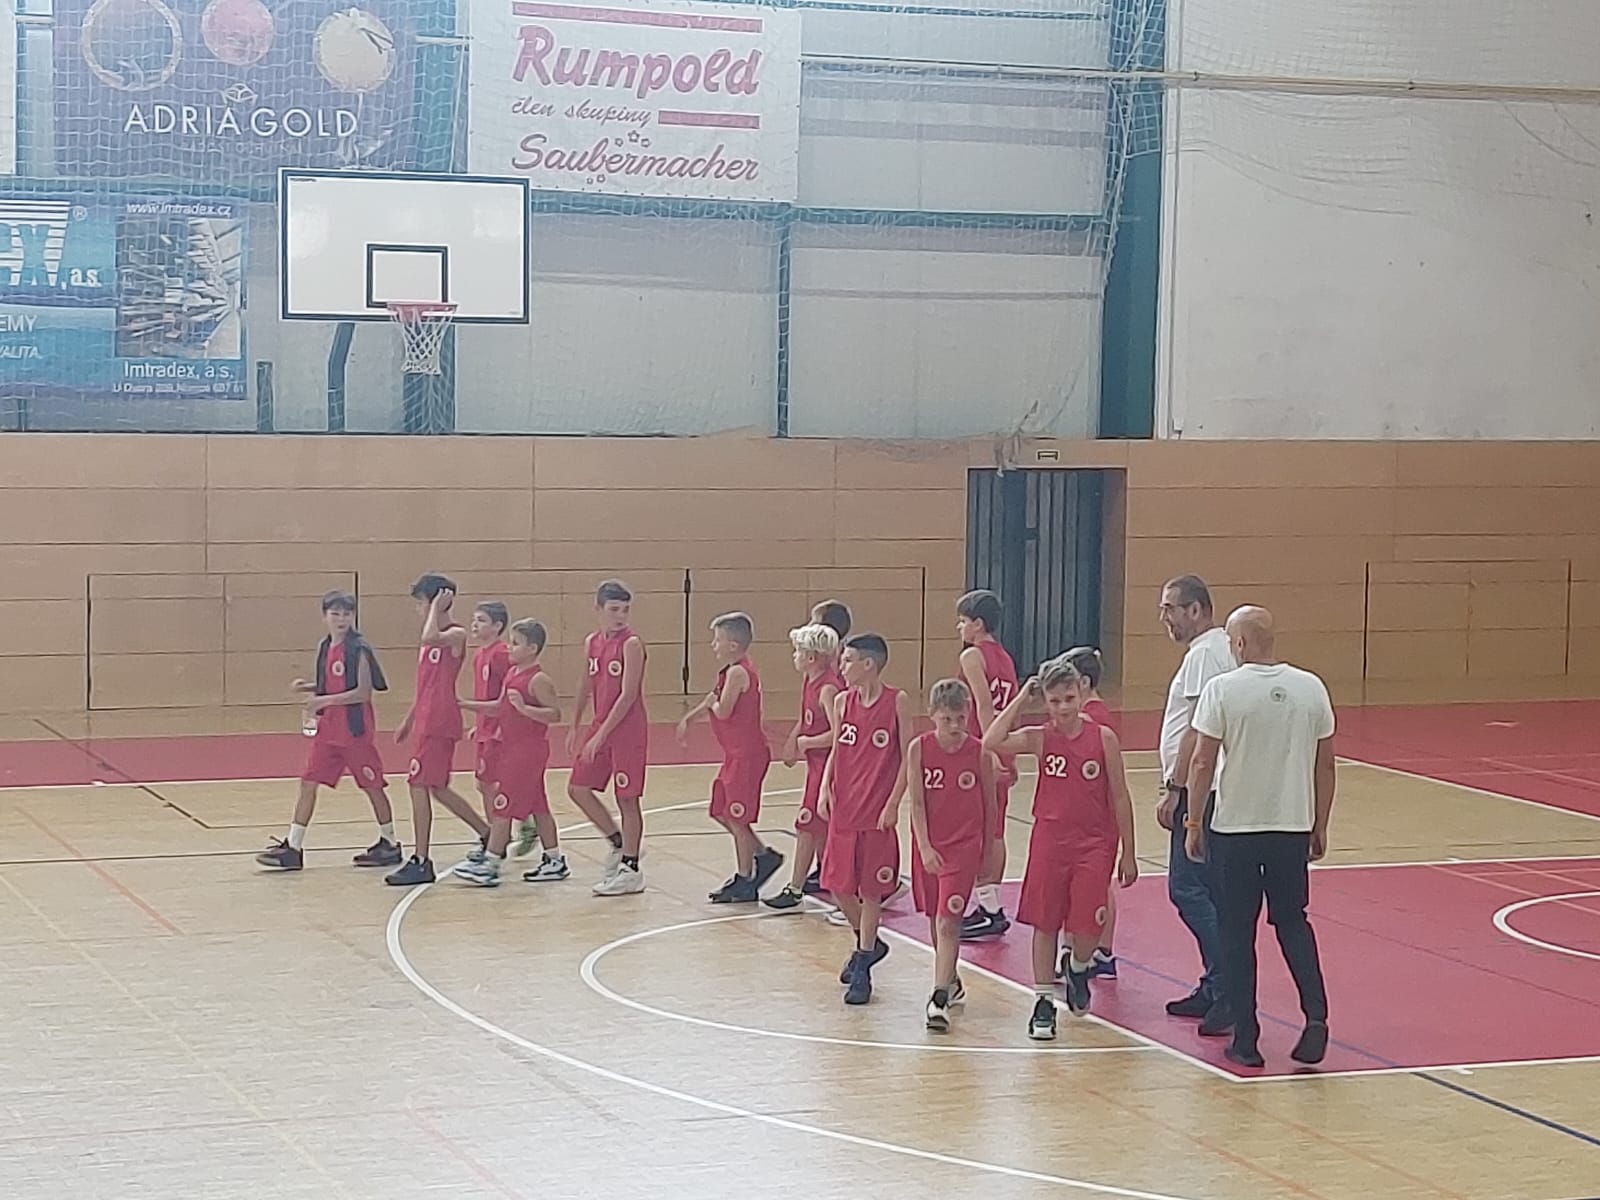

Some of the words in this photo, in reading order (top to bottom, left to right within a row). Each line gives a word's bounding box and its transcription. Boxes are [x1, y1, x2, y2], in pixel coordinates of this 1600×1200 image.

[512, 24, 763, 99] Rumpold
[124, 104, 241, 136] ADRIA
[250, 107, 358, 138] GOLD
[512, 97, 555, 117] člen
[564, 99, 652, 128] skupiny
[512, 133, 760, 180] Saubermacher
[126, 202, 232, 216] www.imtradex.cz
[990, 676, 1012, 715] 27
[838, 722, 857, 745] 26
[924, 767, 944, 789] 22
[1045, 755, 1067, 777] 32
